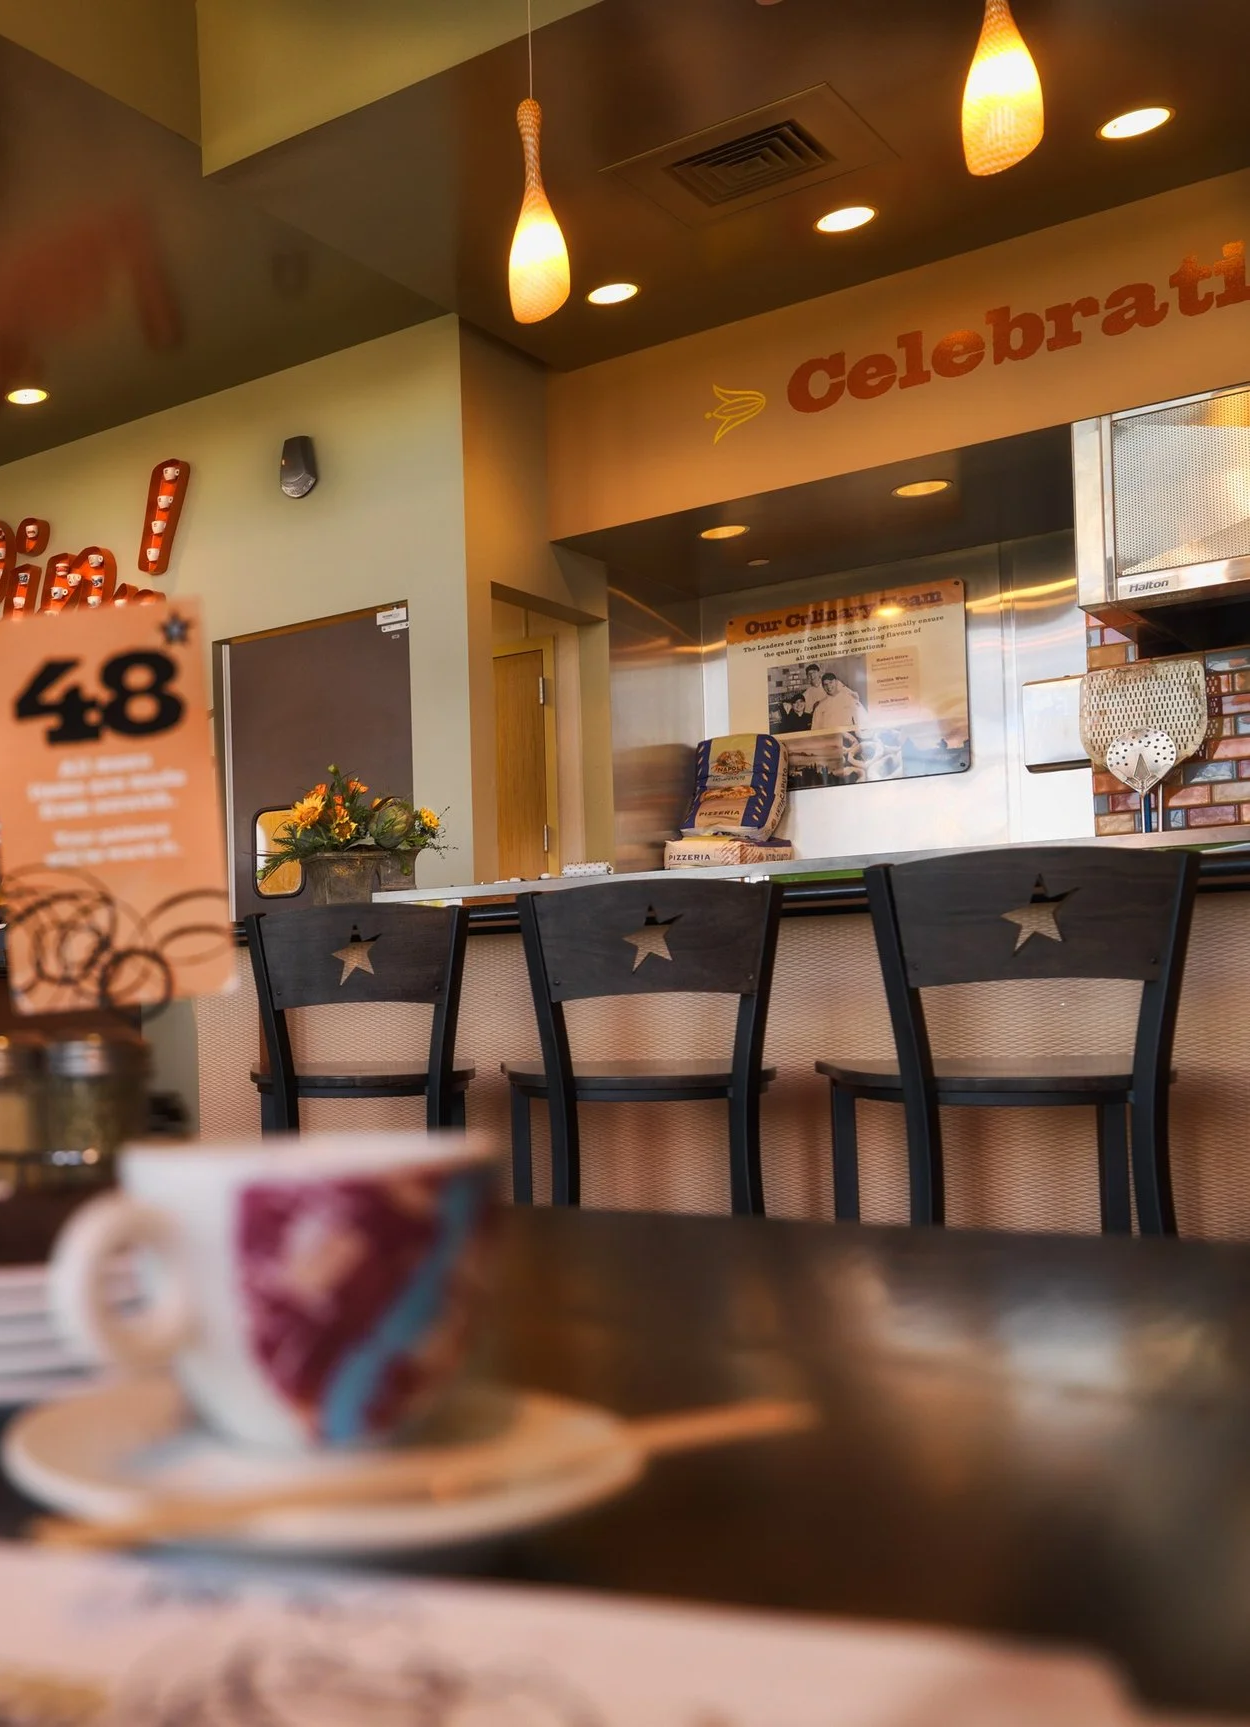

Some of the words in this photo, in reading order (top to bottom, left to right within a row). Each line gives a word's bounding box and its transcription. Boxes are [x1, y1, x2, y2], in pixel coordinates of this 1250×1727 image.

[1128, 579, 1170, 593] Halton
[745, 620, 782, 635] Our
[785, 603, 875, 628] Culinary
[757, 642, 784, 651] Leaders
[807, 633, 837, 643] Culinary
[839, 628, 859, 637] Team
[878, 620, 916, 632] personally
[918, 615, 944, 624] ensure
[776, 648, 802, 657] quality,
[804, 642, 837, 651] freshness
[854, 633, 884, 644] amazing
[886, 630, 912, 638] flavors
[820, 648, 849, 657] culinary
[850, 643, 886, 652] creations.
[14, 650, 188, 746] 48
[716, 765, 745, 773] NAPOLI
